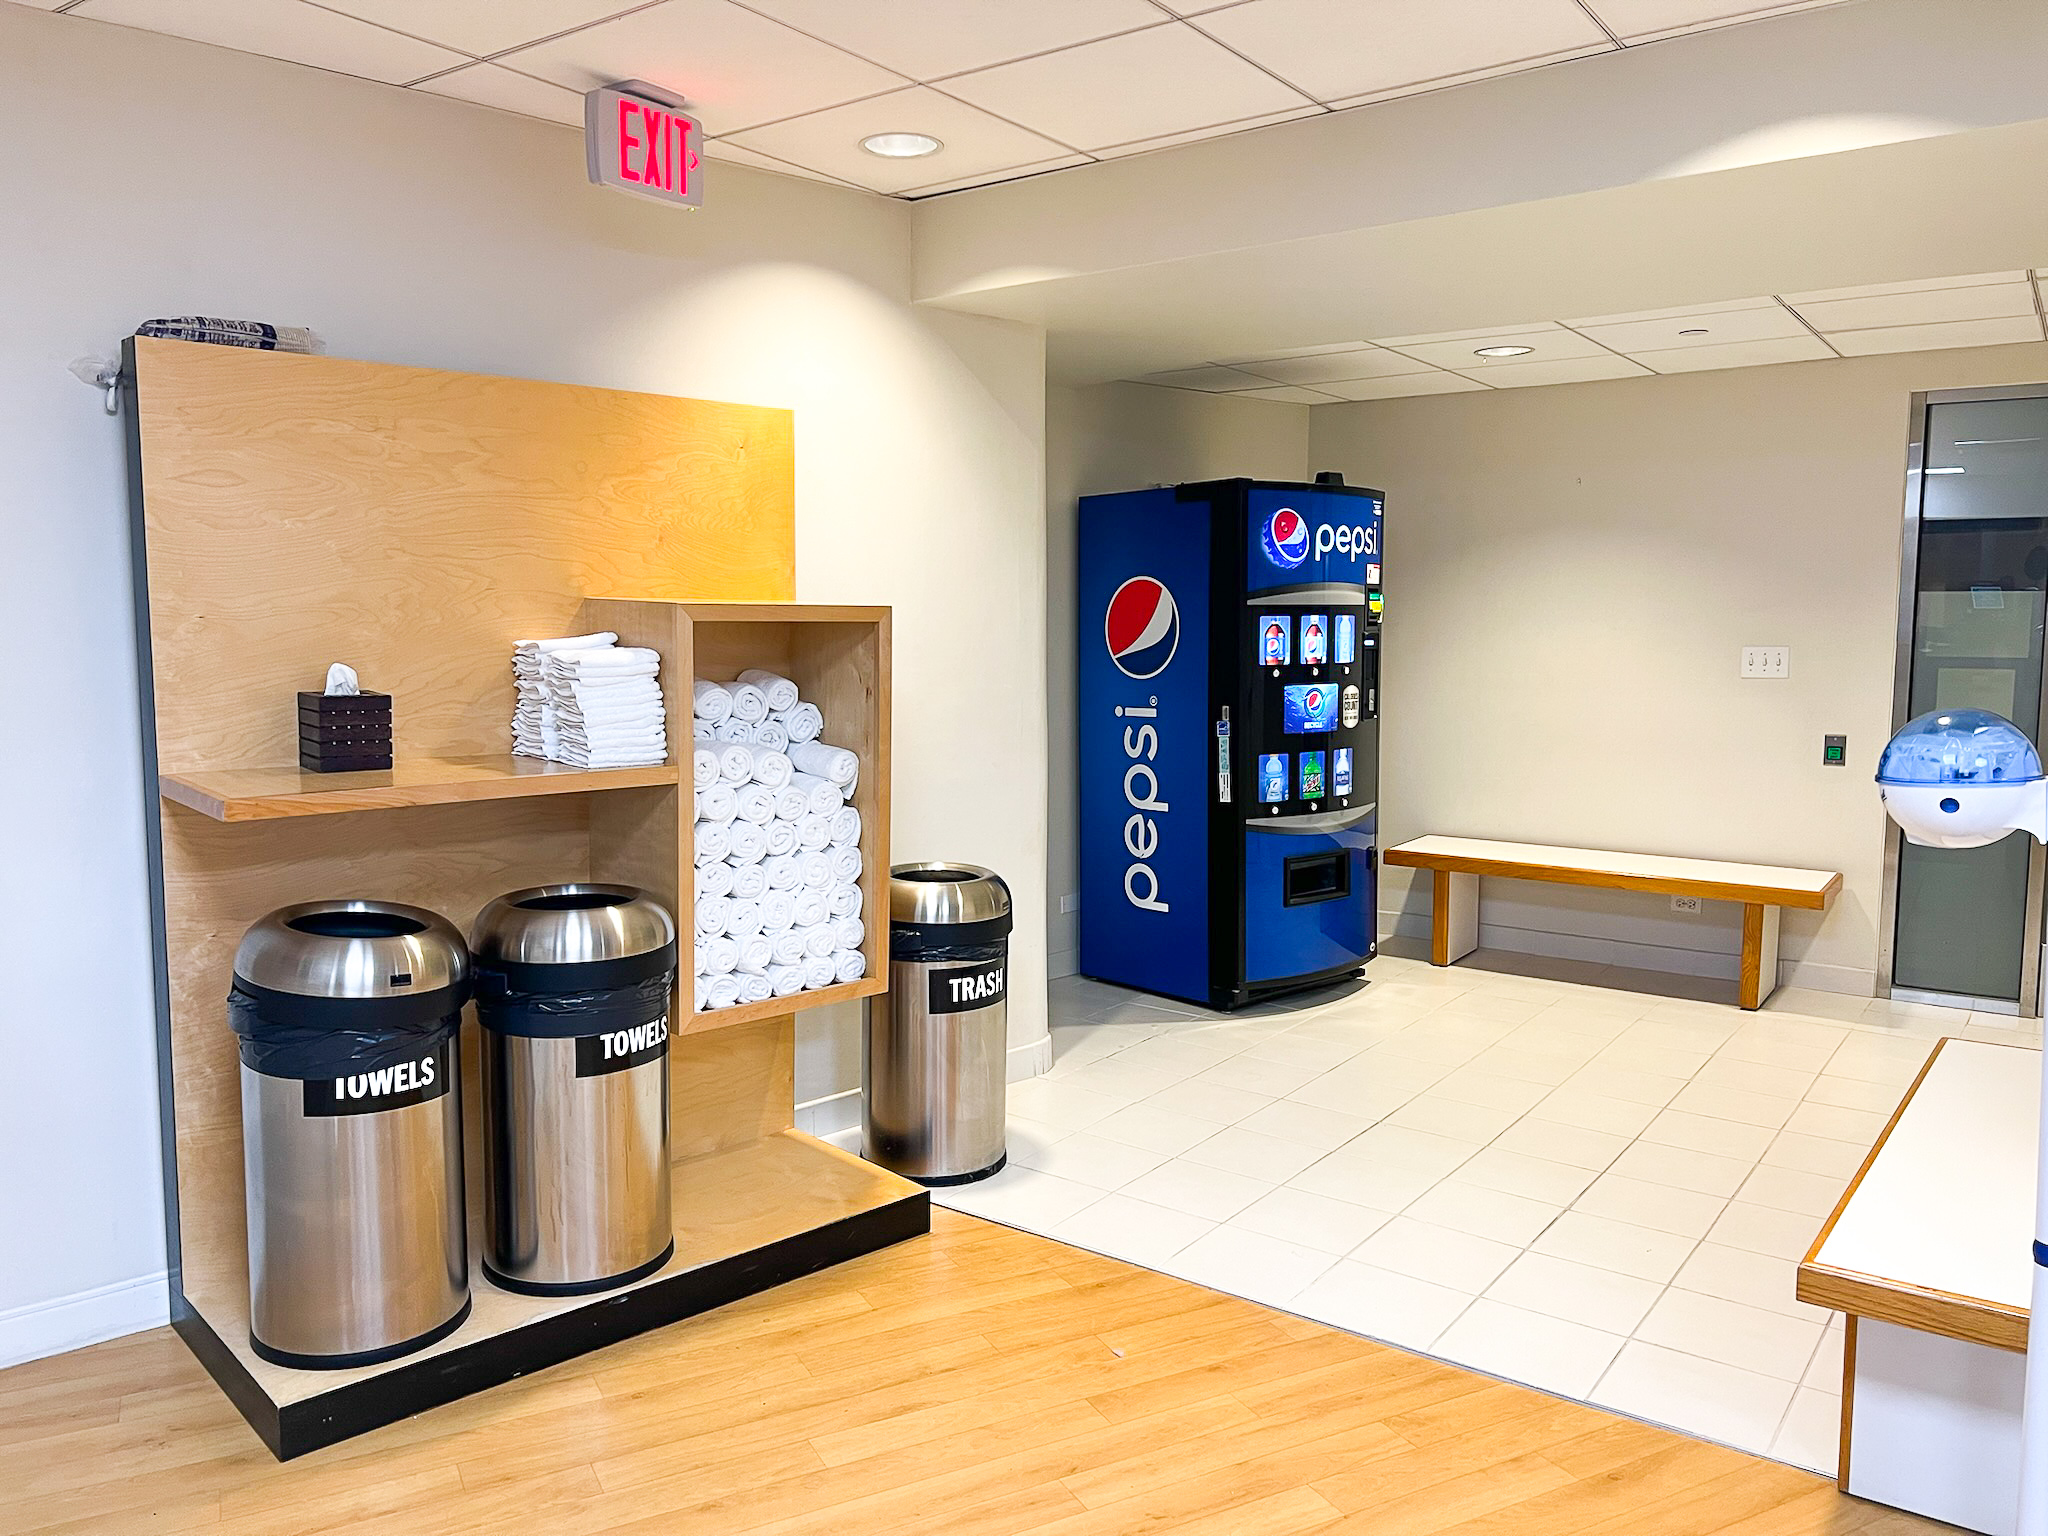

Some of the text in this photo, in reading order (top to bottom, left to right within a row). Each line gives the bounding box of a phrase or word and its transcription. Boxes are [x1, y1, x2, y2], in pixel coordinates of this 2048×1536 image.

[619, 98, 693, 196] EXIT
[1315, 521, 1378, 562] pepsi
[949, 967, 1004, 1003] TRASH
[600, 1015, 668, 1060] TOWELS
